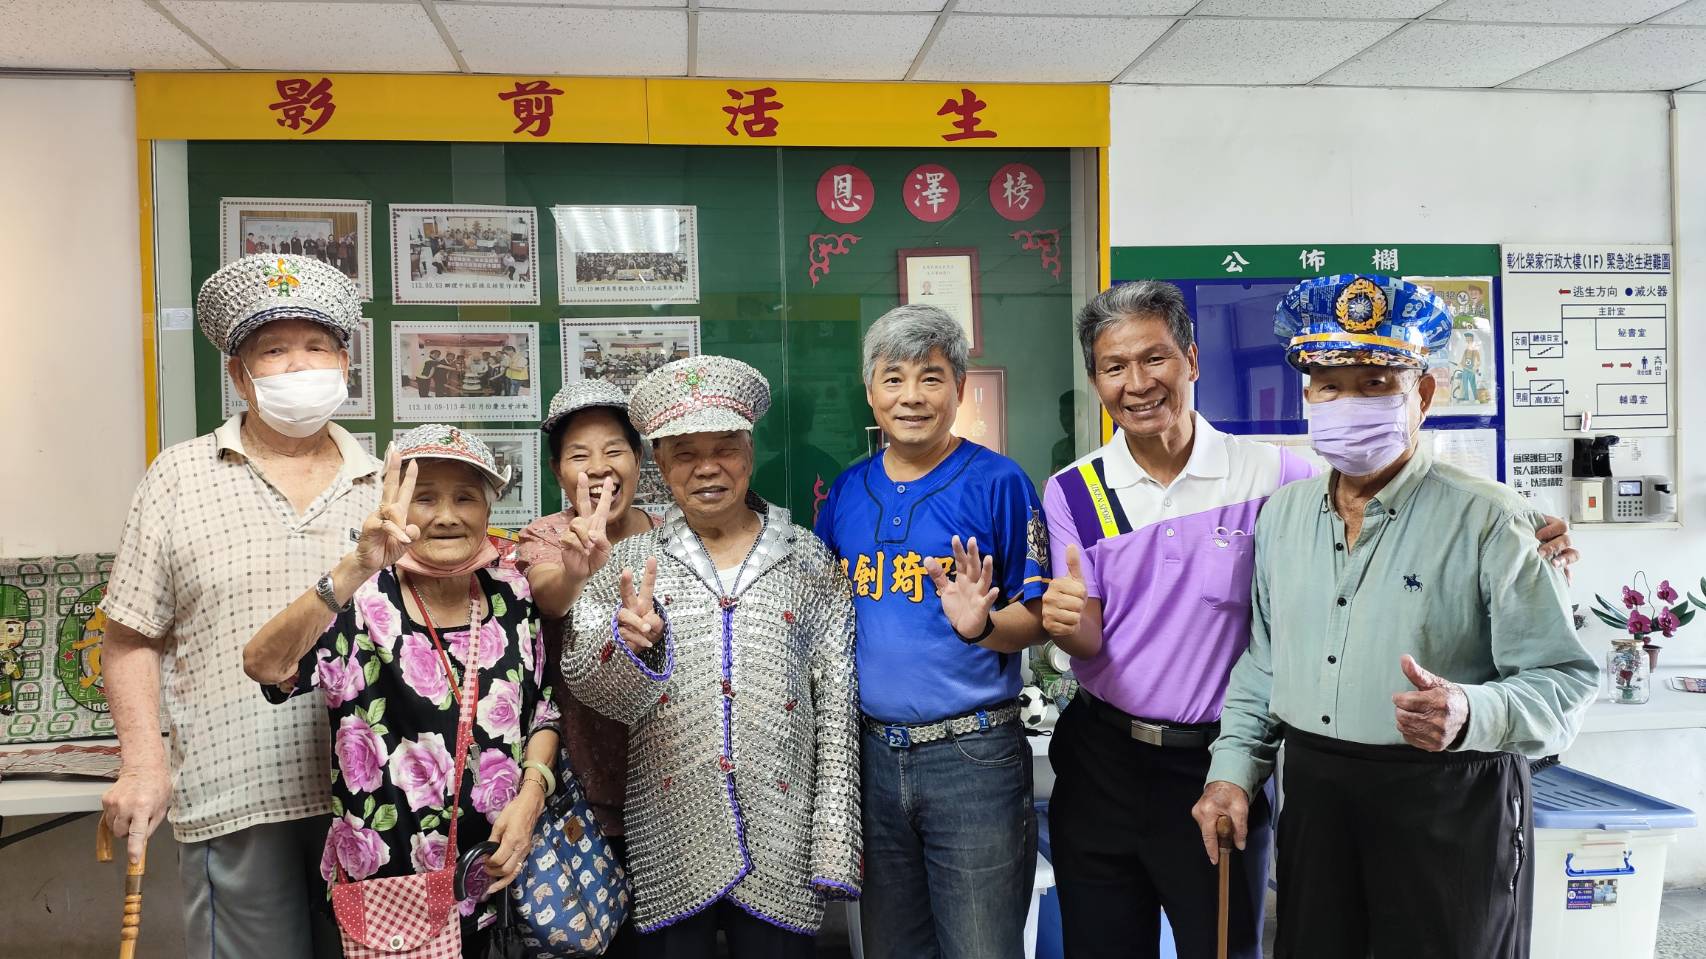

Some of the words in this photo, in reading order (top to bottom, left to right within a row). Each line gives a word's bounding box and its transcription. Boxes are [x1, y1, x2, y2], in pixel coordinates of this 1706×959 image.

[831, 172, 1034, 214] 恩澤榜
[1221, 248, 1400, 273] 公佈欄
[1573, 286, 1618, 298] 逃生方向
[1634, 286, 1668, 298] 滅火器
[1598, 307, 1626, 317] 主計室
[1617, 328, 1647, 338] 秘書室
[1619, 395, 1648, 405] 輔導室
